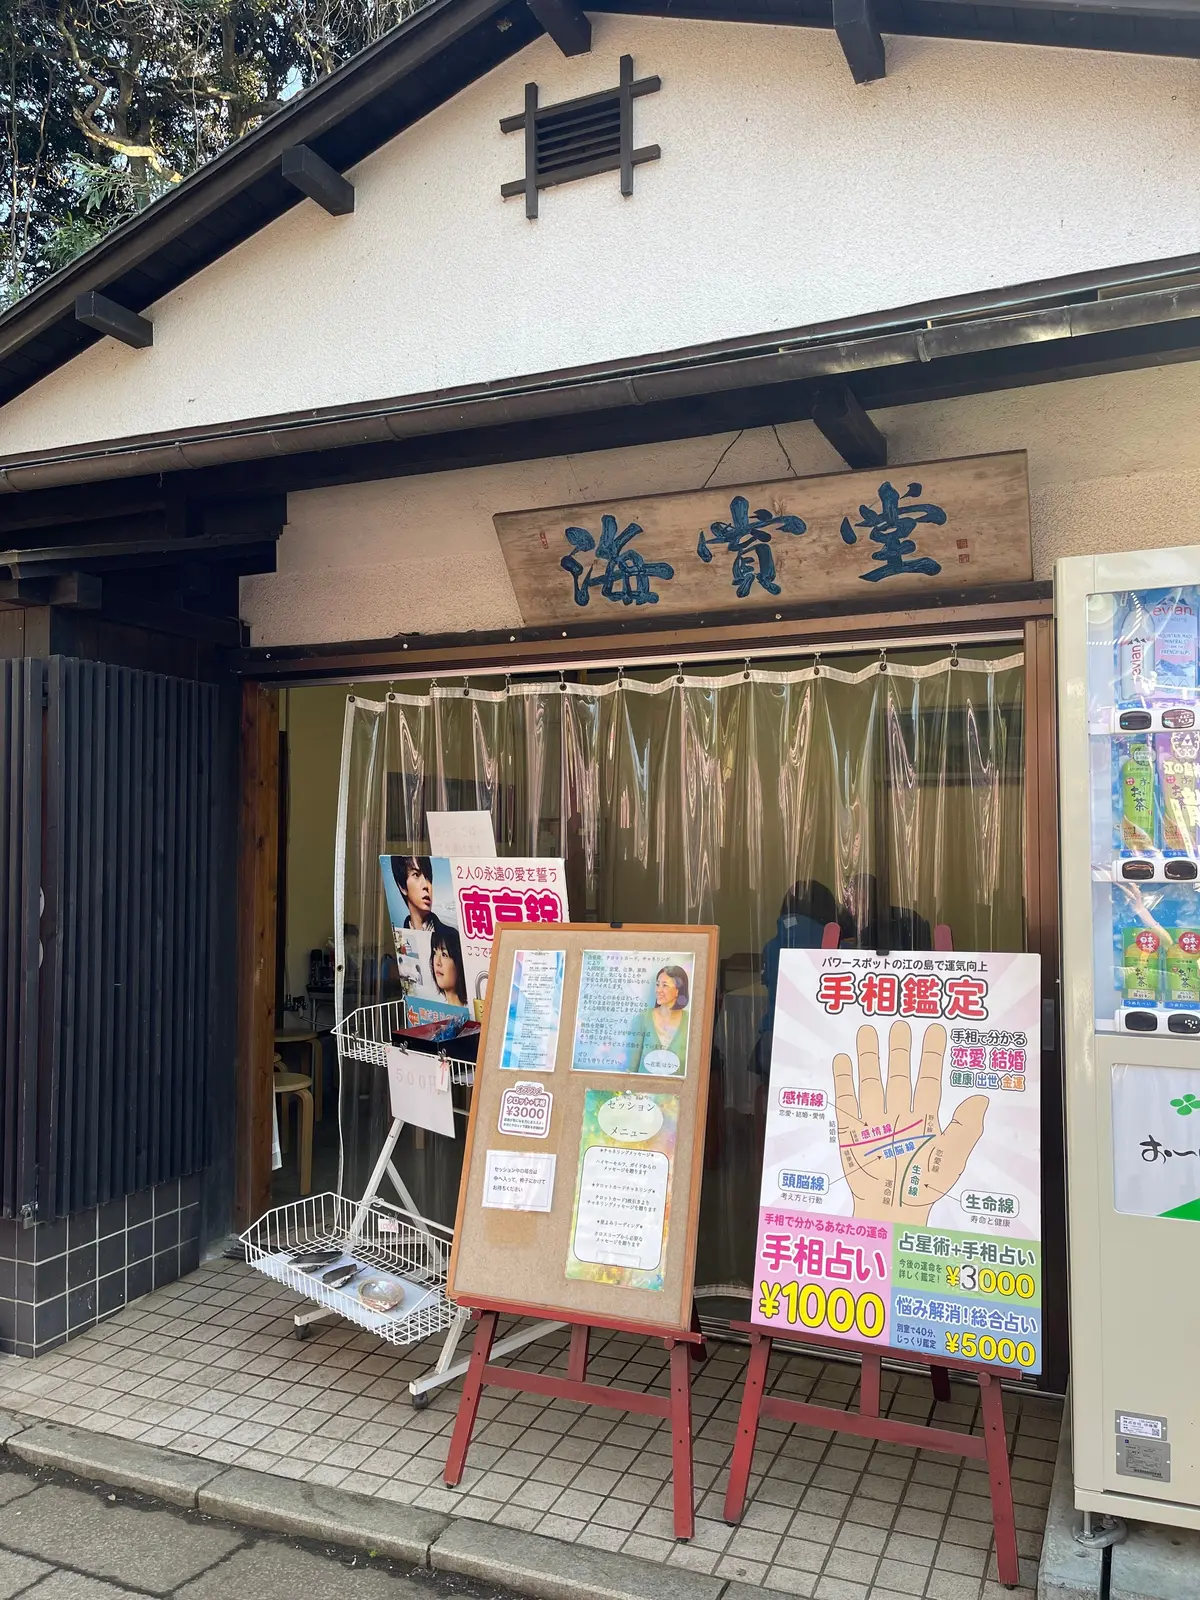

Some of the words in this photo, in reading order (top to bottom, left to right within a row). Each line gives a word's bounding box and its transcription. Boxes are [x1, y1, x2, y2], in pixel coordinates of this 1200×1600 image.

[1153, 606, 1195, 617] evian
[1131, 643, 1142, 676] evian
[466, 945, 493, 958] ここで
[822, 956, 988, 972] パワースポットの江の島で運気向上
[817, 972, 989, 1020] 手相鑑定
[951, 1029, 1027, 1047] 手相で分かる
[950, 1047, 986, 1070] 恋愛
[991, 1048, 1026, 1072] 結婚
[950, 1072, 974, 1089] 健康
[975, 1073, 999, 1090] 出世
[1001, 1075, 1026, 1092] 金運
[608, 1100, 656, 1112] セッション
[782, 1090, 824, 1108] 感情線
[506, 1105, 545, 1120] ¥3000
[610, 1126, 648, 1138] メニュー
[829, 1120, 837, 1144] 結婚線
[860, 1123, 893, 1141] 感情線
[883, 1141, 916, 1160] 頭脳線
[494, 1166, 538, 1175] セッション中の場合は
[931, 1149, 945, 1173] 恋愛線
[492, 1184, 524, 1192] お待ちください
[781, 1172, 825, 1192] 頭脳線
[907, 1165, 922, 1197] 生命線
[780, 1193, 824, 1206] 考え方と行動
[882, 1178, 894, 1206] 運命線
[965, 1194, 1015, 1214] 生命線
[764, 1213, 889, 1240] 手相で分かるあなたの運命
[969, 1215, 1012, 1228] 寿命と健康
[762, 1233, 887, 1282] 手相占い
[898, 1232, 1036, 1266] 占星術+手相占い
[899, 1259, 942, 1274] 今後の運命を
[899, 1270, 941, 1284] 詳しく鑑定!
[945, 1264, 1035, 1299] ¥3000
[760, 1281, 885, 1338] ¥1000
[895, 1296, 1037, 1334] 悩み解消!総合占い
[896, 1335, 937, 1350] じっくり鑑定
[945, 1331, 1036, 1367] ¥5000
